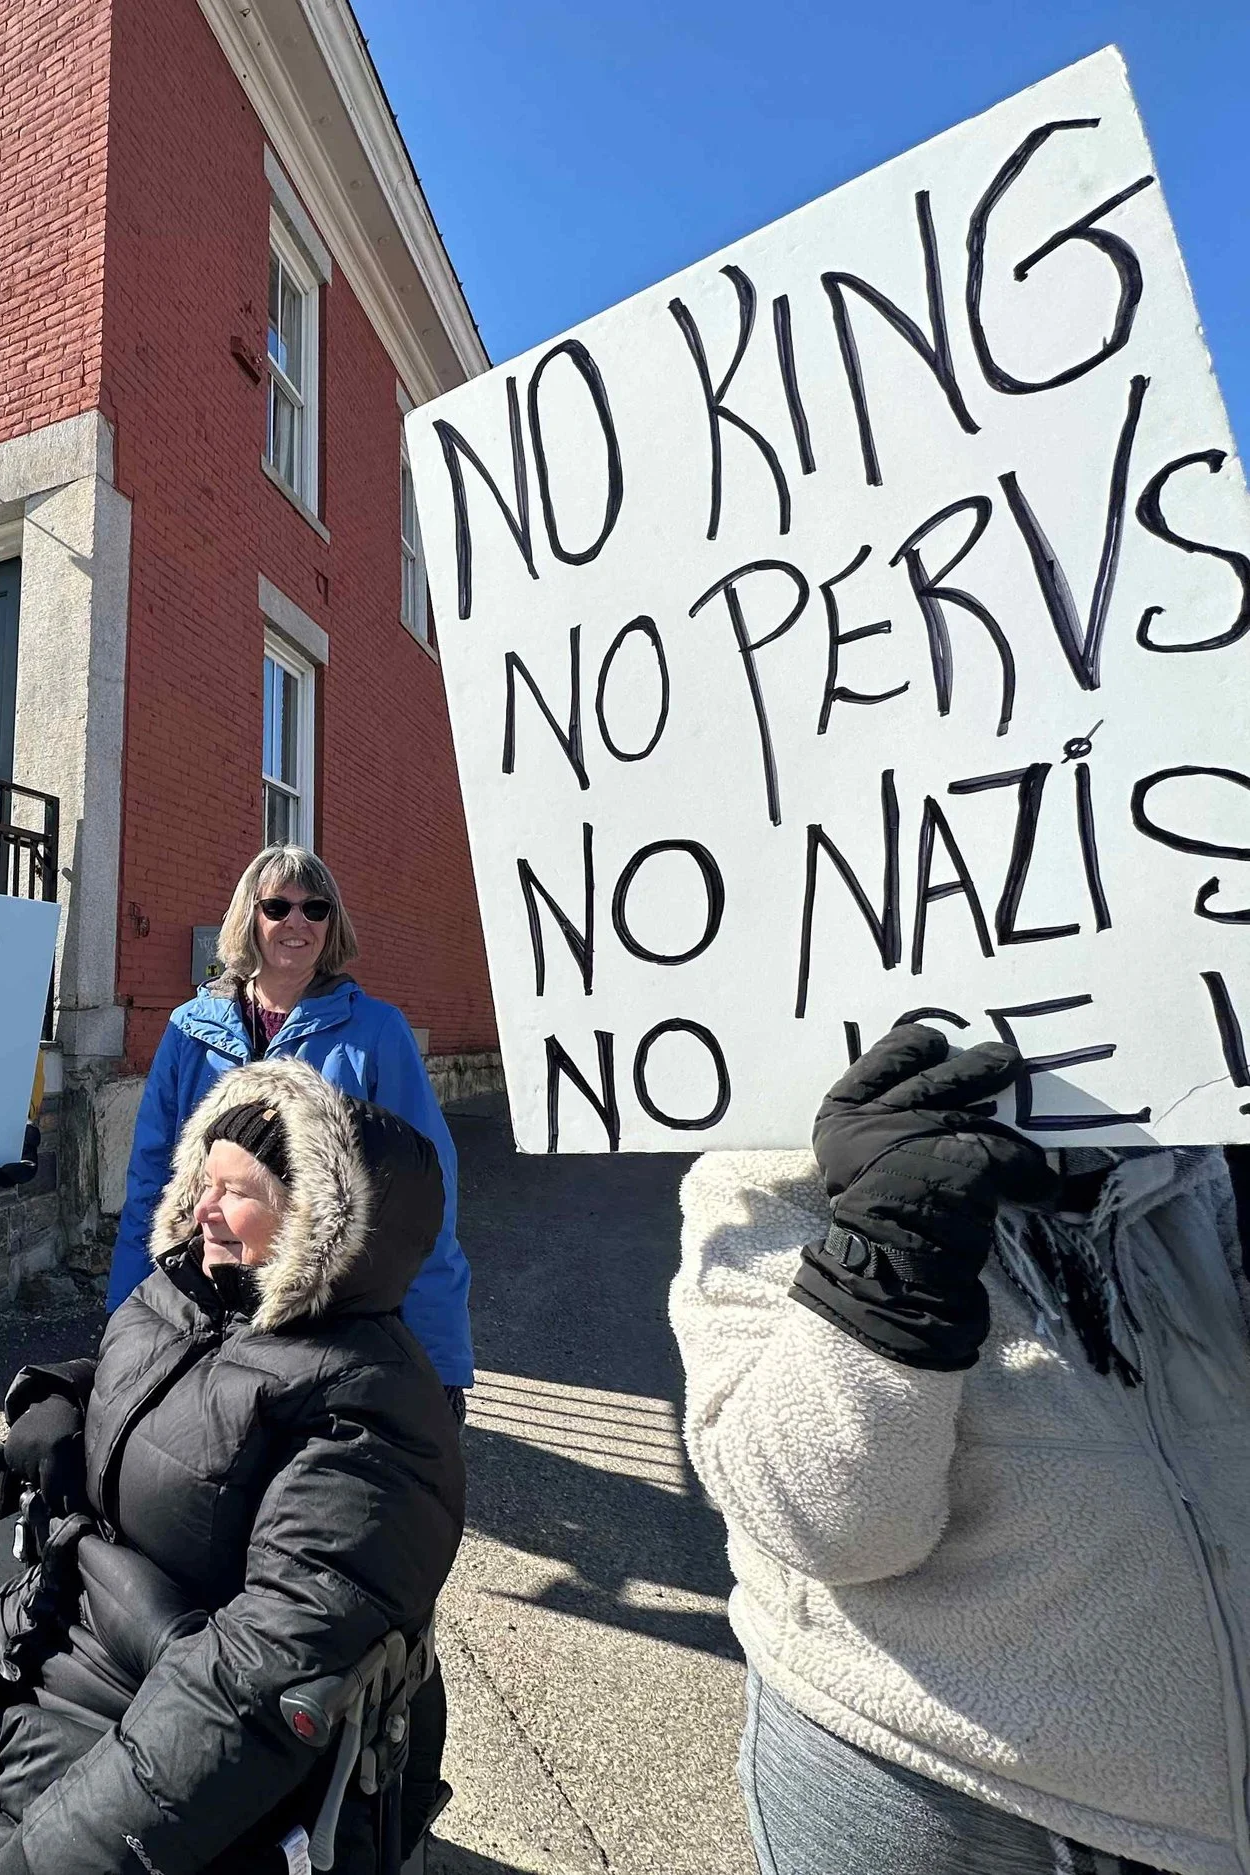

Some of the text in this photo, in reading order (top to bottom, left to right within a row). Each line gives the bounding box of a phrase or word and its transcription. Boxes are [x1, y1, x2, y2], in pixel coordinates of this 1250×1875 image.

[433, 117, 1155, 620] NO KING
[502, 374, 1250, 826] NO PERVS
[516, 719, 1250, 1019] NO NAZIS
[543, 1017, 731, 1154] NO
